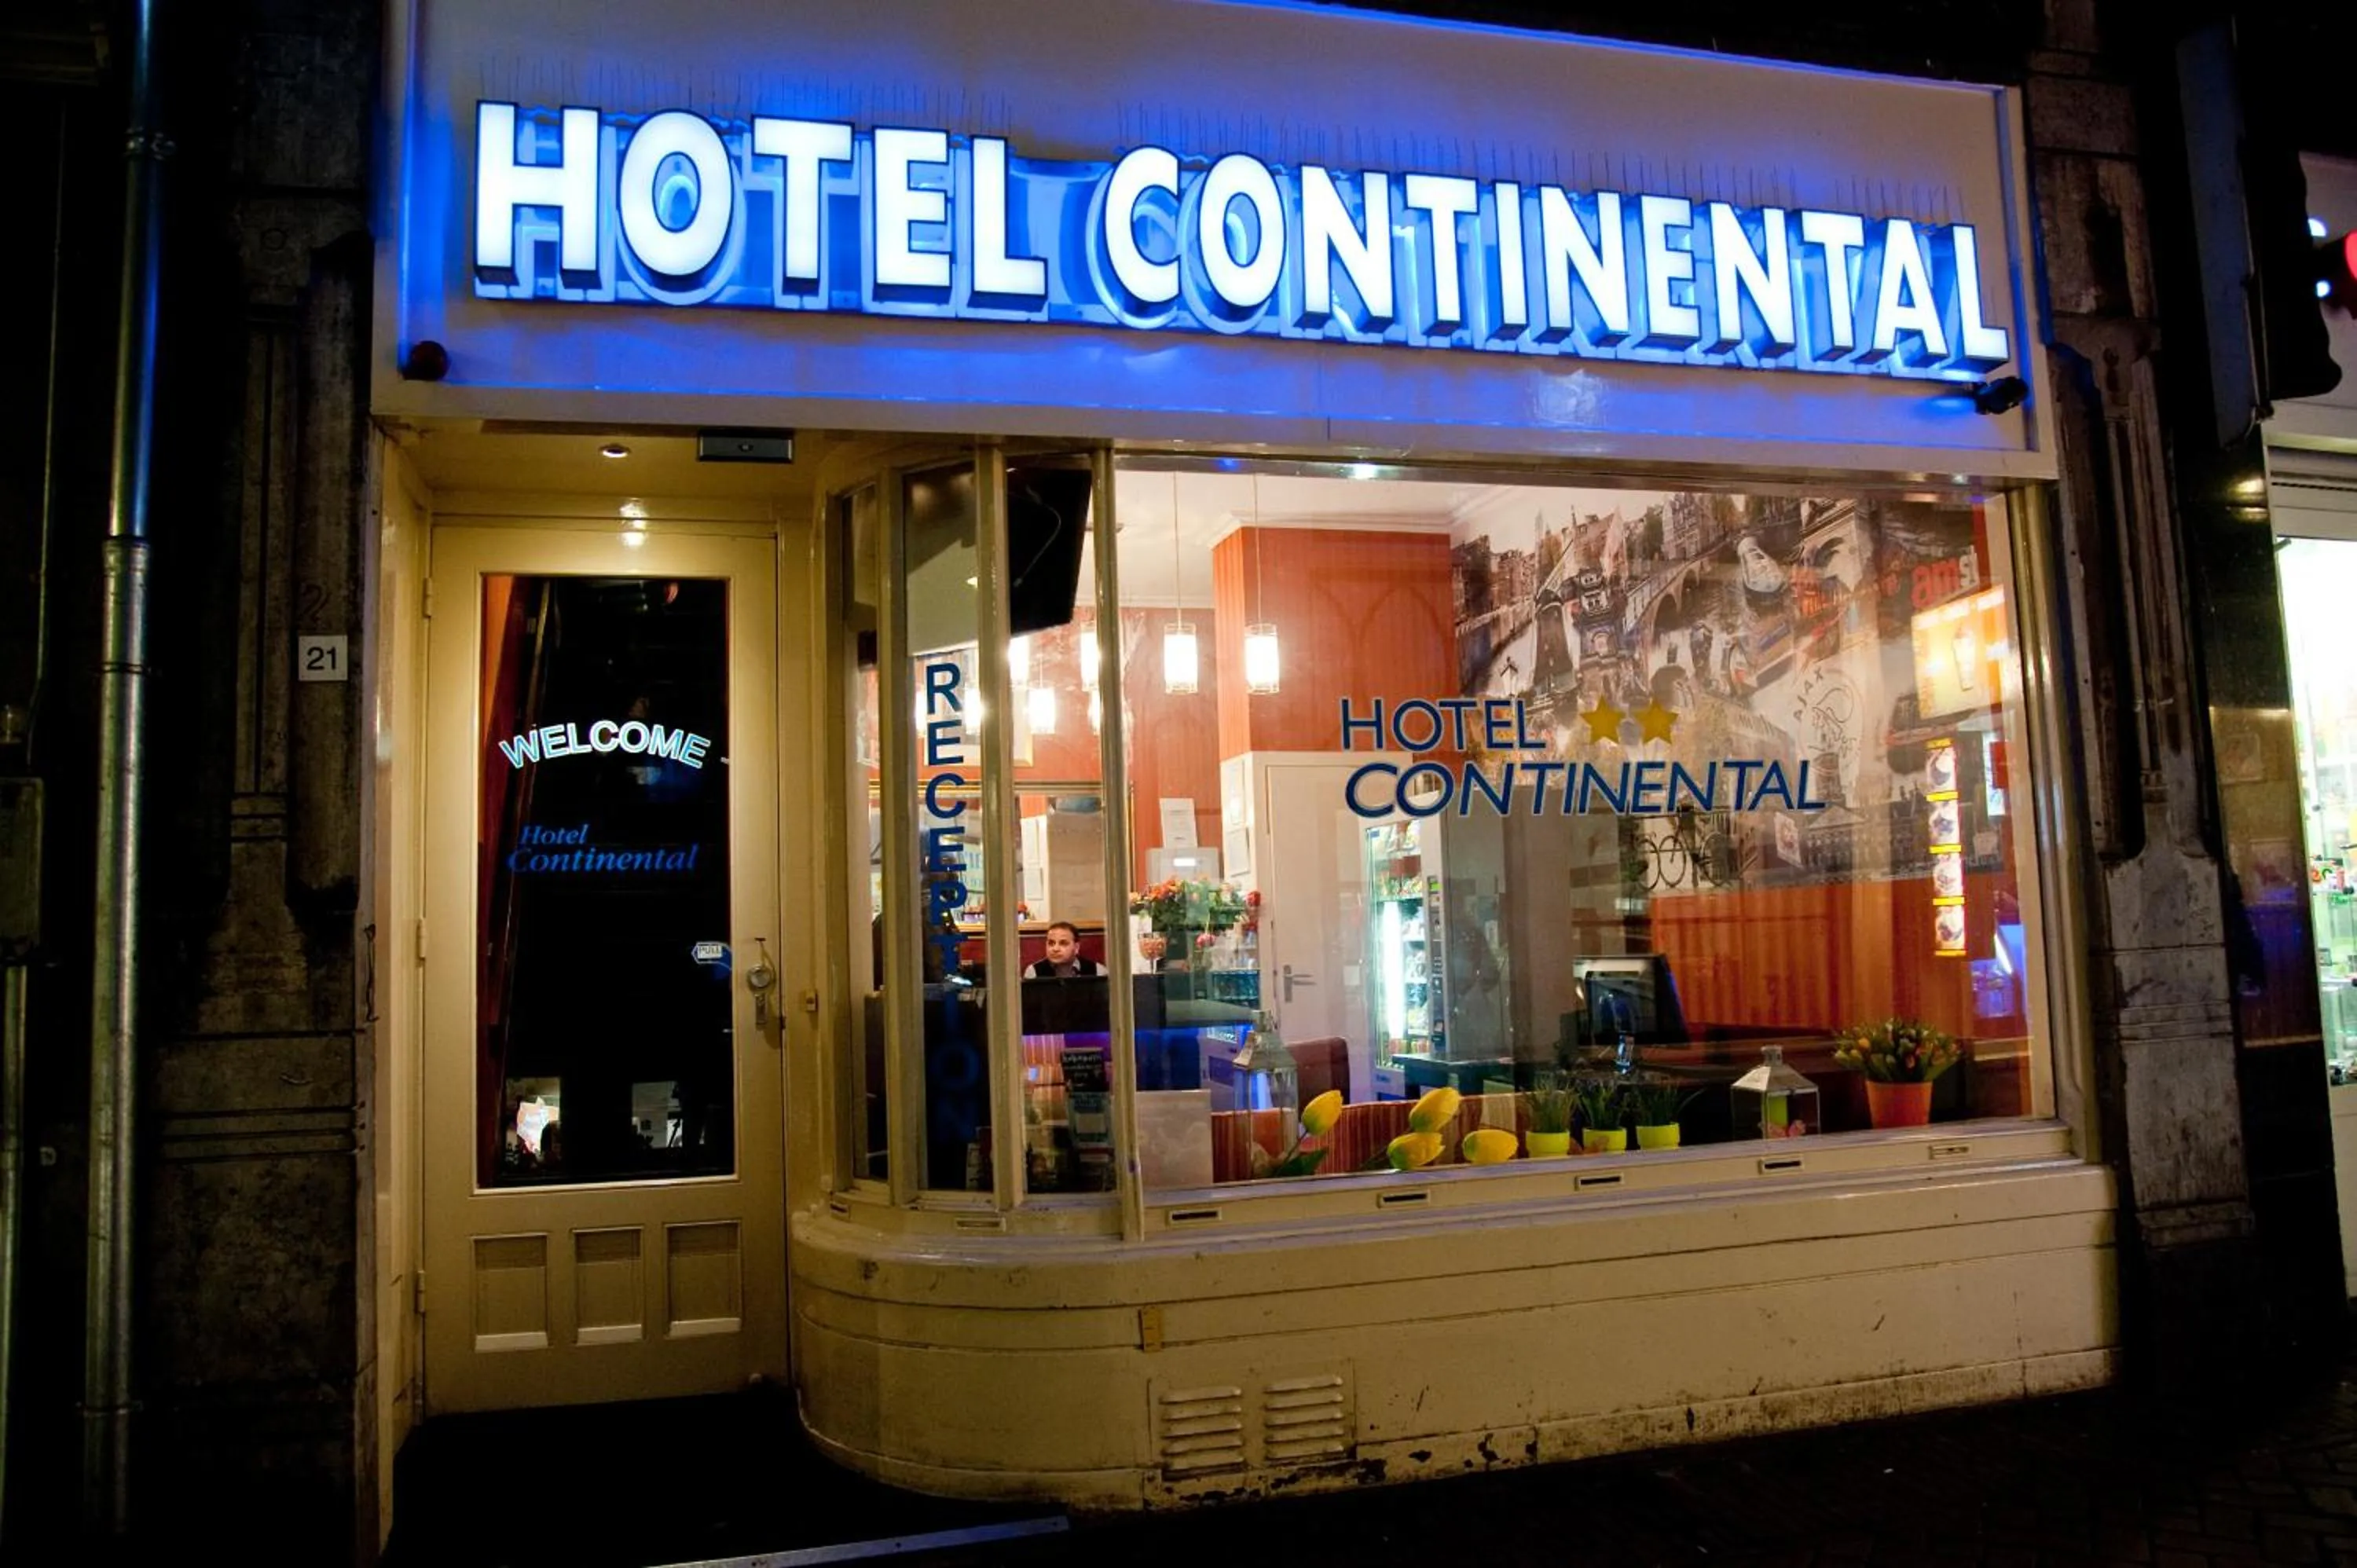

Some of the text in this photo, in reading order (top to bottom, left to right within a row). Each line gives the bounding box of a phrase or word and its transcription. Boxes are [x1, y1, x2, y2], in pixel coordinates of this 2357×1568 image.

[473, 100, 2011, 373] HOTEL CONTINENTAL
[306, 647, 336, 670] 21
[498, 720, 711, 769] WELCOME
[1340, 698, 1546, 751] HOTEL
[1344, 759, 1828, 818] CONTINENTAL
[507, 844, 699, 873] Continental
[520, 824, 588, 845] Hotel
